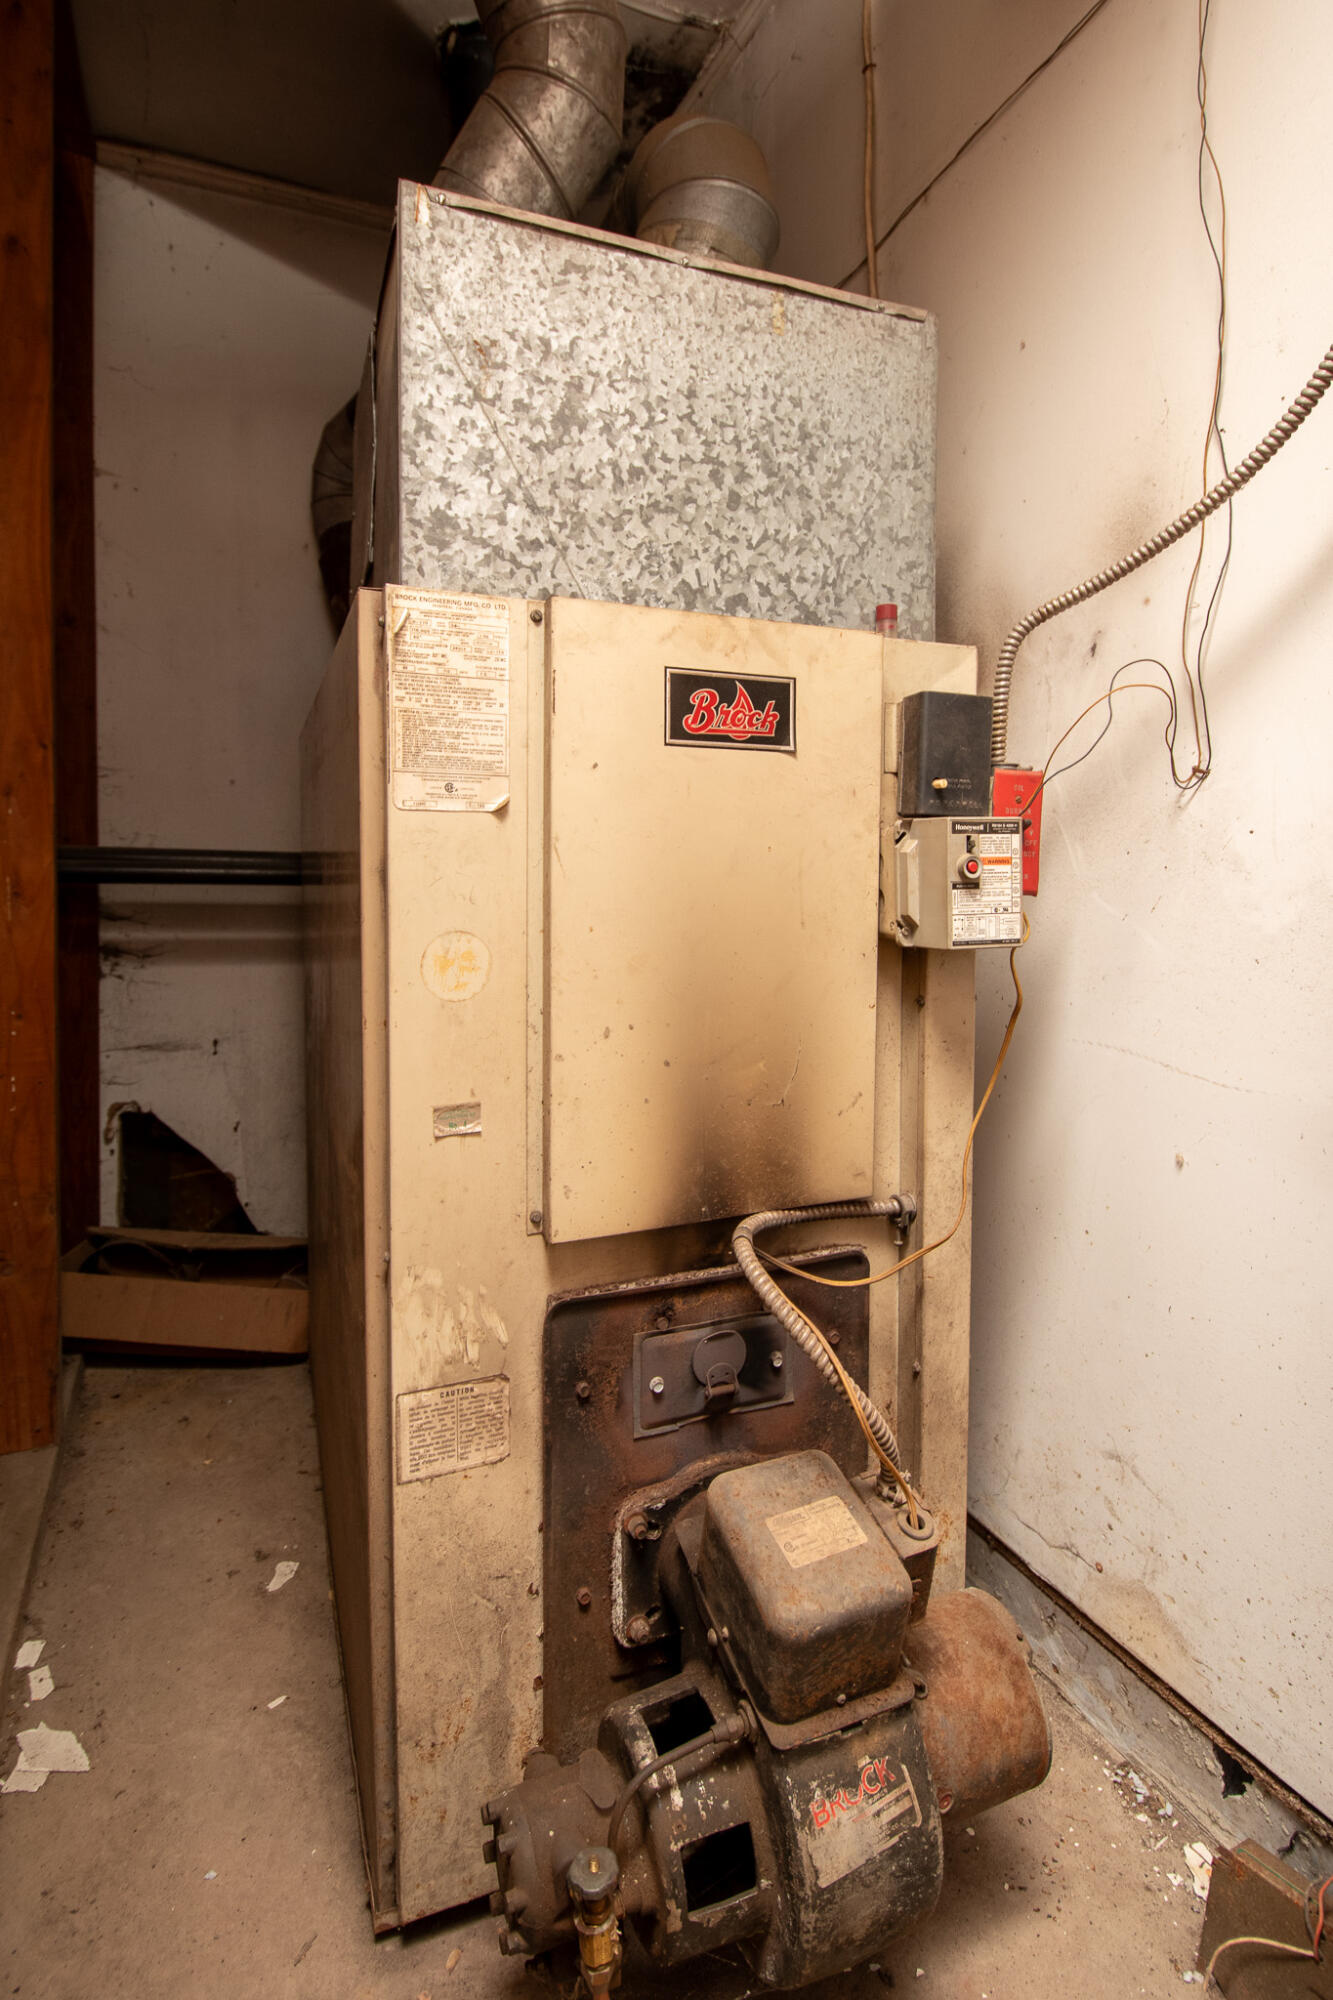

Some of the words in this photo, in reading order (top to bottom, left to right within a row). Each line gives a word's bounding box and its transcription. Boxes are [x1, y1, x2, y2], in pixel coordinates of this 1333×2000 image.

[394, 593, 417, 601] BROCK
[419, 595, 462, 606] ENGINEERING
[682, 684, 780, 738] Brock
[955, 823, 984, 832] Honeywell
[440, 1386, 475, 1399] CAUTION
